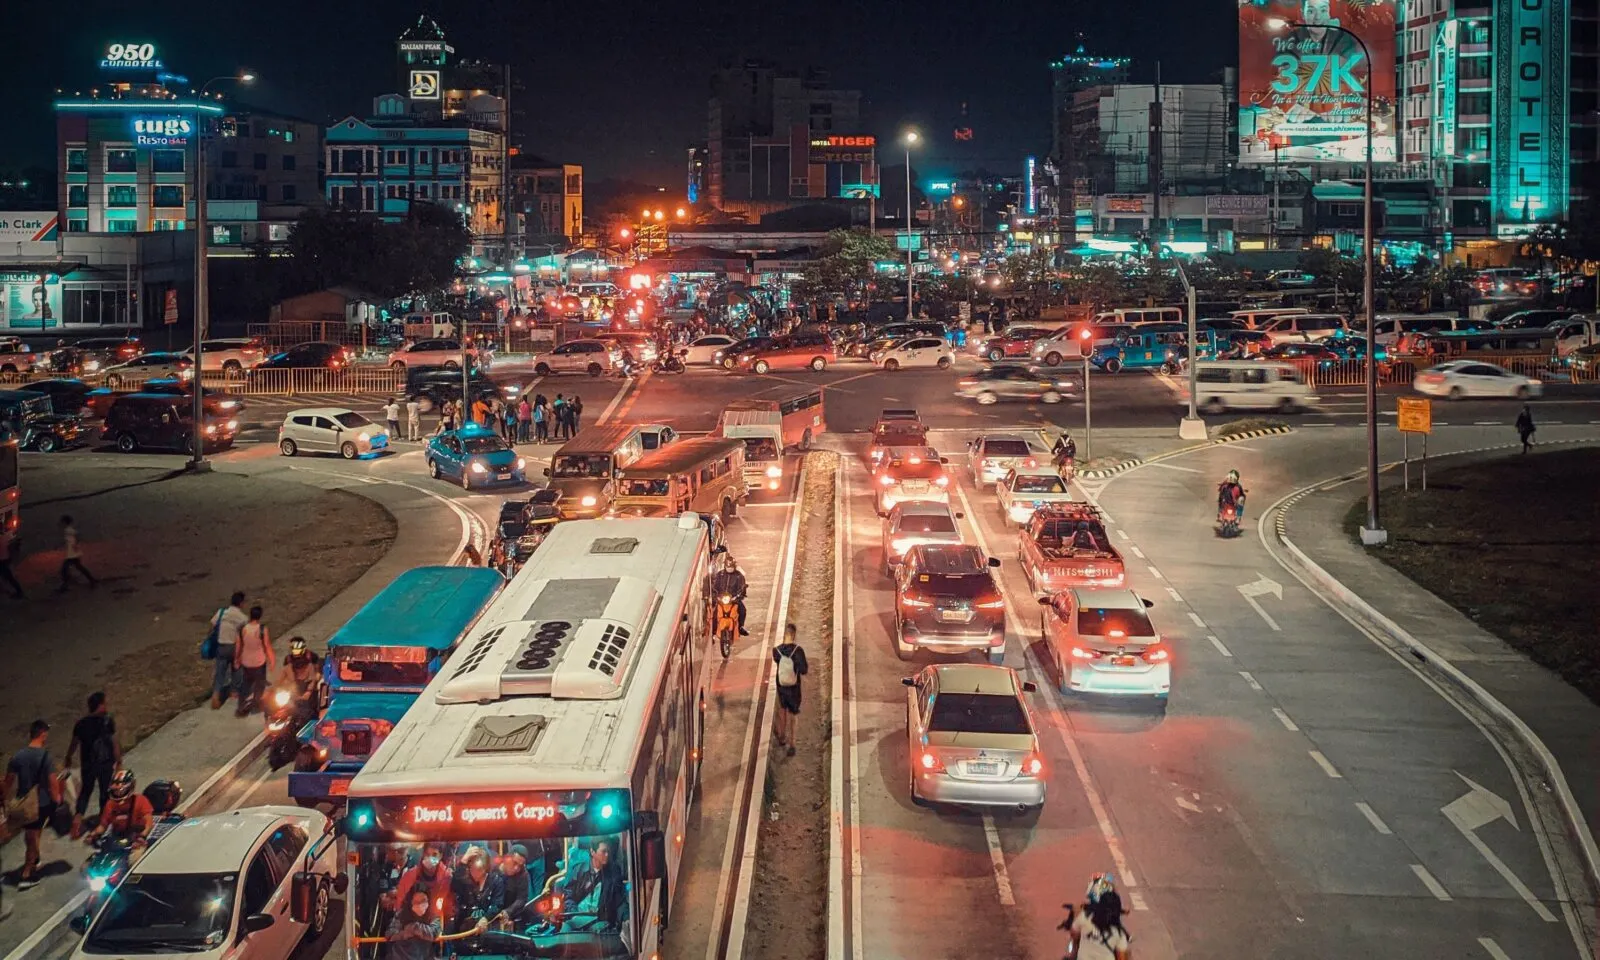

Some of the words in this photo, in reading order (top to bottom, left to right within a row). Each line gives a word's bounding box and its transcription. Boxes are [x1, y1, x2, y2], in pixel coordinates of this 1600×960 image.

[107, 43, 154, 61] 950
[1273, 37, 1295, 51] We
[1297, 39, 1321, 53] offer
[1271, 53, 1365, 93] 37K
[135, 120, 190, 136] tugs
[829, 136, 875, 146] TIGER
[13, 219, 42, 229] Clark
[414, 805, 453, 823] Devel
[514, 802, 555, 820] Corpo
